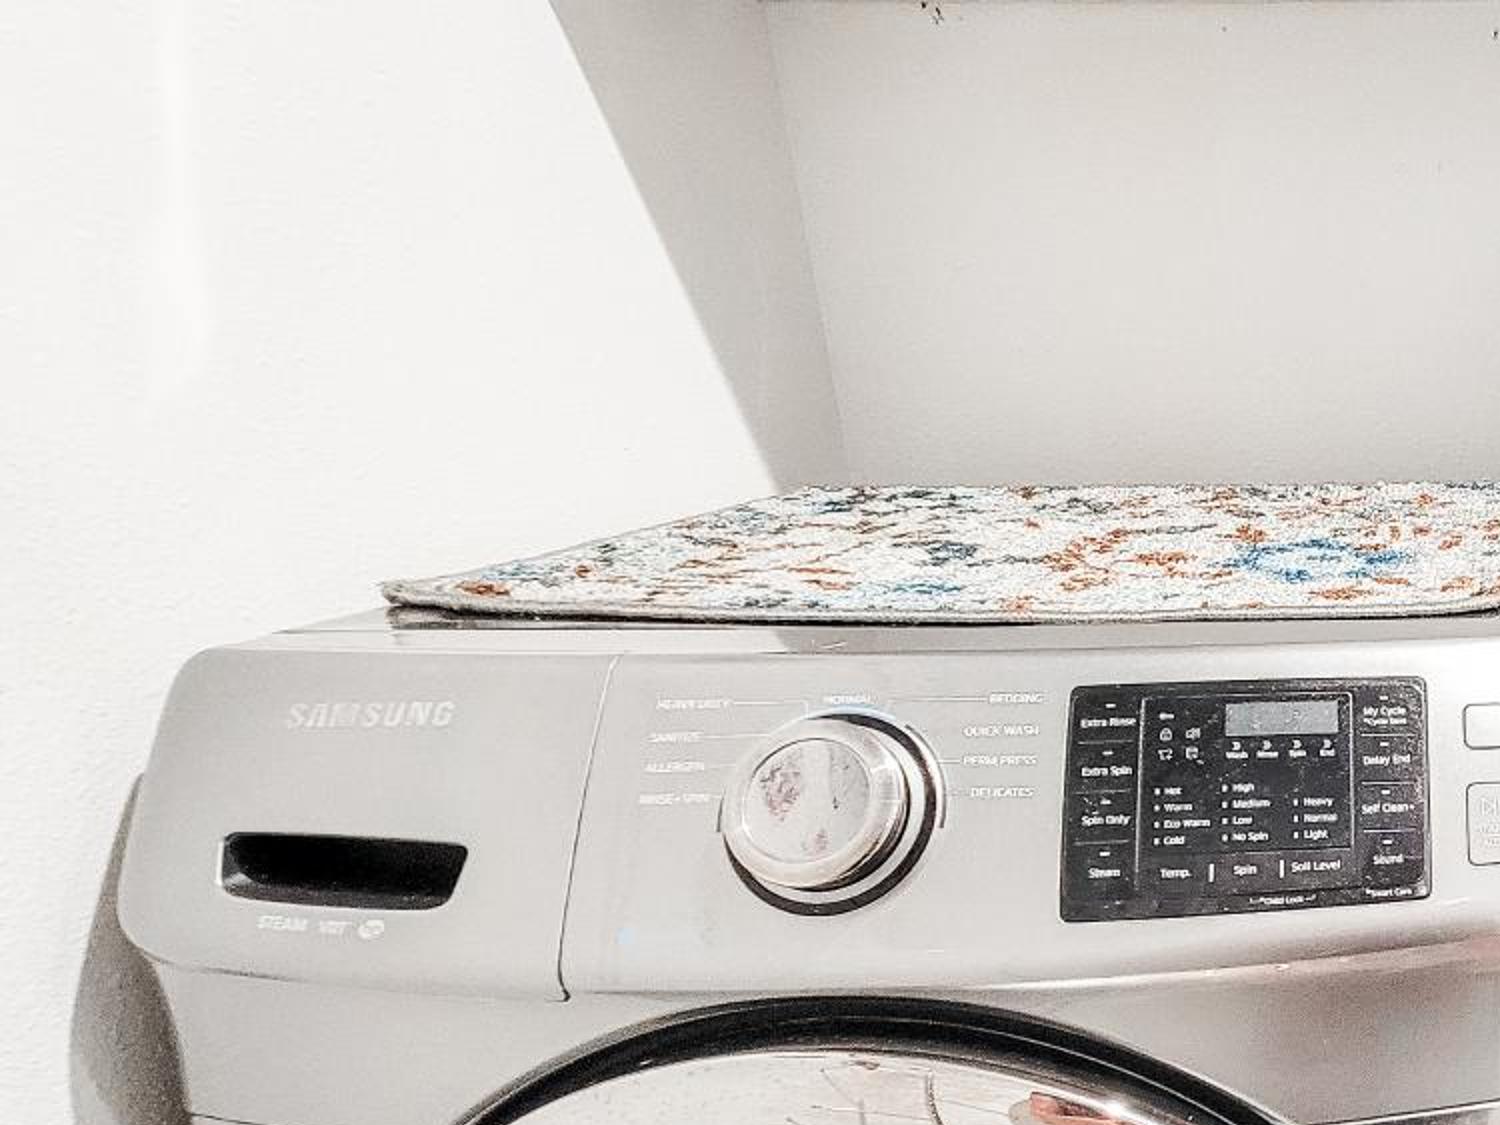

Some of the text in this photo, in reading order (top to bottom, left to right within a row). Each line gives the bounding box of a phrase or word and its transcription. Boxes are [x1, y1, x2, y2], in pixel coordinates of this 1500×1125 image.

[285, 701, 456, 727] SAMSUNG
[1363, 705, 1407, 718] My Cycle
[1081, 717, 1136, 728] Extra Rinse
[1003, 724, 1040, 736] WASH
[1363, 752, 1412, 766] Delay End
[1081, 765, 1133, 777] Extra Spin
[971, 786, 1035, 798] DELICATES
[1231, 782, 1255, 793] High
[1163, 803, 1193, 812] Warm
[1232, 799, 1271, 809] Medium
[1303, 796, 1334, 807] Heavy
[1361, 802, 1381, 815] Self
[1081, 813, 1132, 827] Spin Only
[1163, 818, 1211, 829] Eco Warm
[1232, 815, 1253, 825] Low
[1303, 813, 1338, 822] Normal
[1163, 835, 1186, 845] Cold
[1232, 831, 1269, 842] No Spin
[1303, 829, 1329, 840] Light
[1373, 853, 1404, 866] Sound
[1233, 864, 1257, 876] Spin
[1291, 859, 1341, 873] Soil Level
[1088, 867, 1121, 879] Steam
[1160, 867, 1192, 879] Temp.
